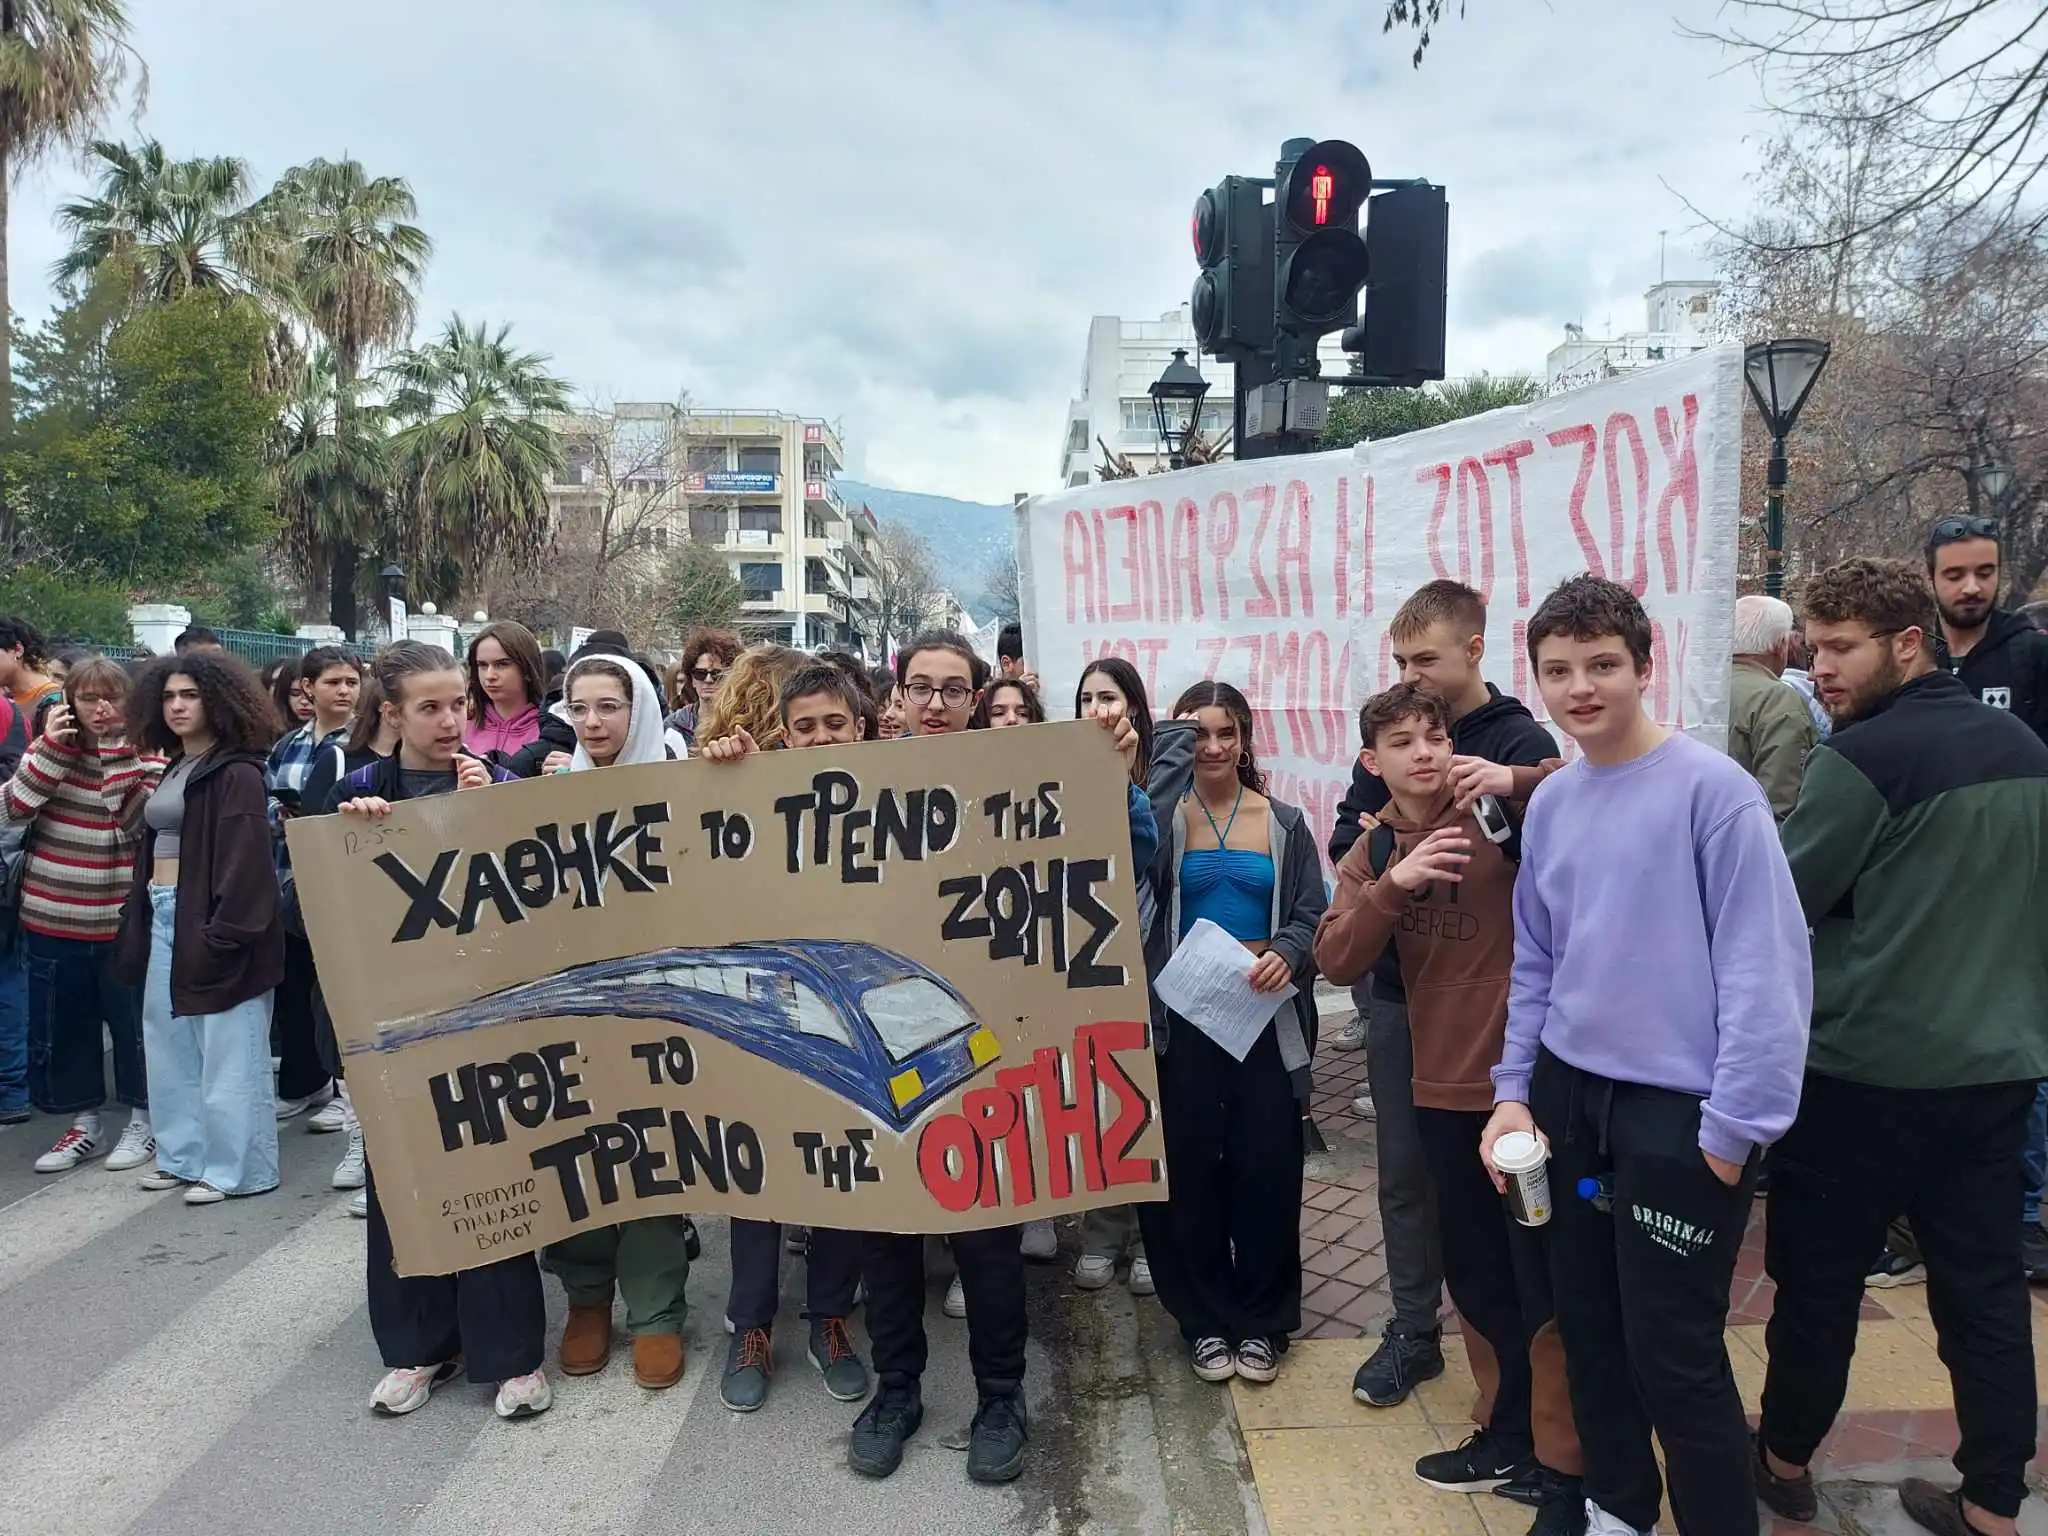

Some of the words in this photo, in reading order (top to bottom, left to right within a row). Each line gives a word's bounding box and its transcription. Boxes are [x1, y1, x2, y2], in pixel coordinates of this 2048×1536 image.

[372, 801, 672, 943] ΧΑΘΗΚΕ
[701, 809, 755, 860] ΤΟ
[774, 768, 960, 884] ΤΡΕΝΟ
[984, 781, 1065, 840] ΤΗΣ
[939, 855, 1130, 989] ΖΩΗΣ
[428, 1041, 596, 1152] ΗΡΘΕ
[631, 1036, 699, 1086] ΤΟ
[529, 1107, 766, 1223] ΤΡΕΝΟ
[793, 1128, 885, 1193] ΤΗΣ
[917, 1020, 1162, 1212] ΟΡΓΗΣ
[464, 1178, 536, 1210] ΠΡΟΤΥΠΟ
[1632, 1204, 1716, 1246] ORIGINAL
[476, 1219, 532, 1250] ΒΟΛΟΥ
[1650, 1233, 1689, 1257] ADMIRAL
